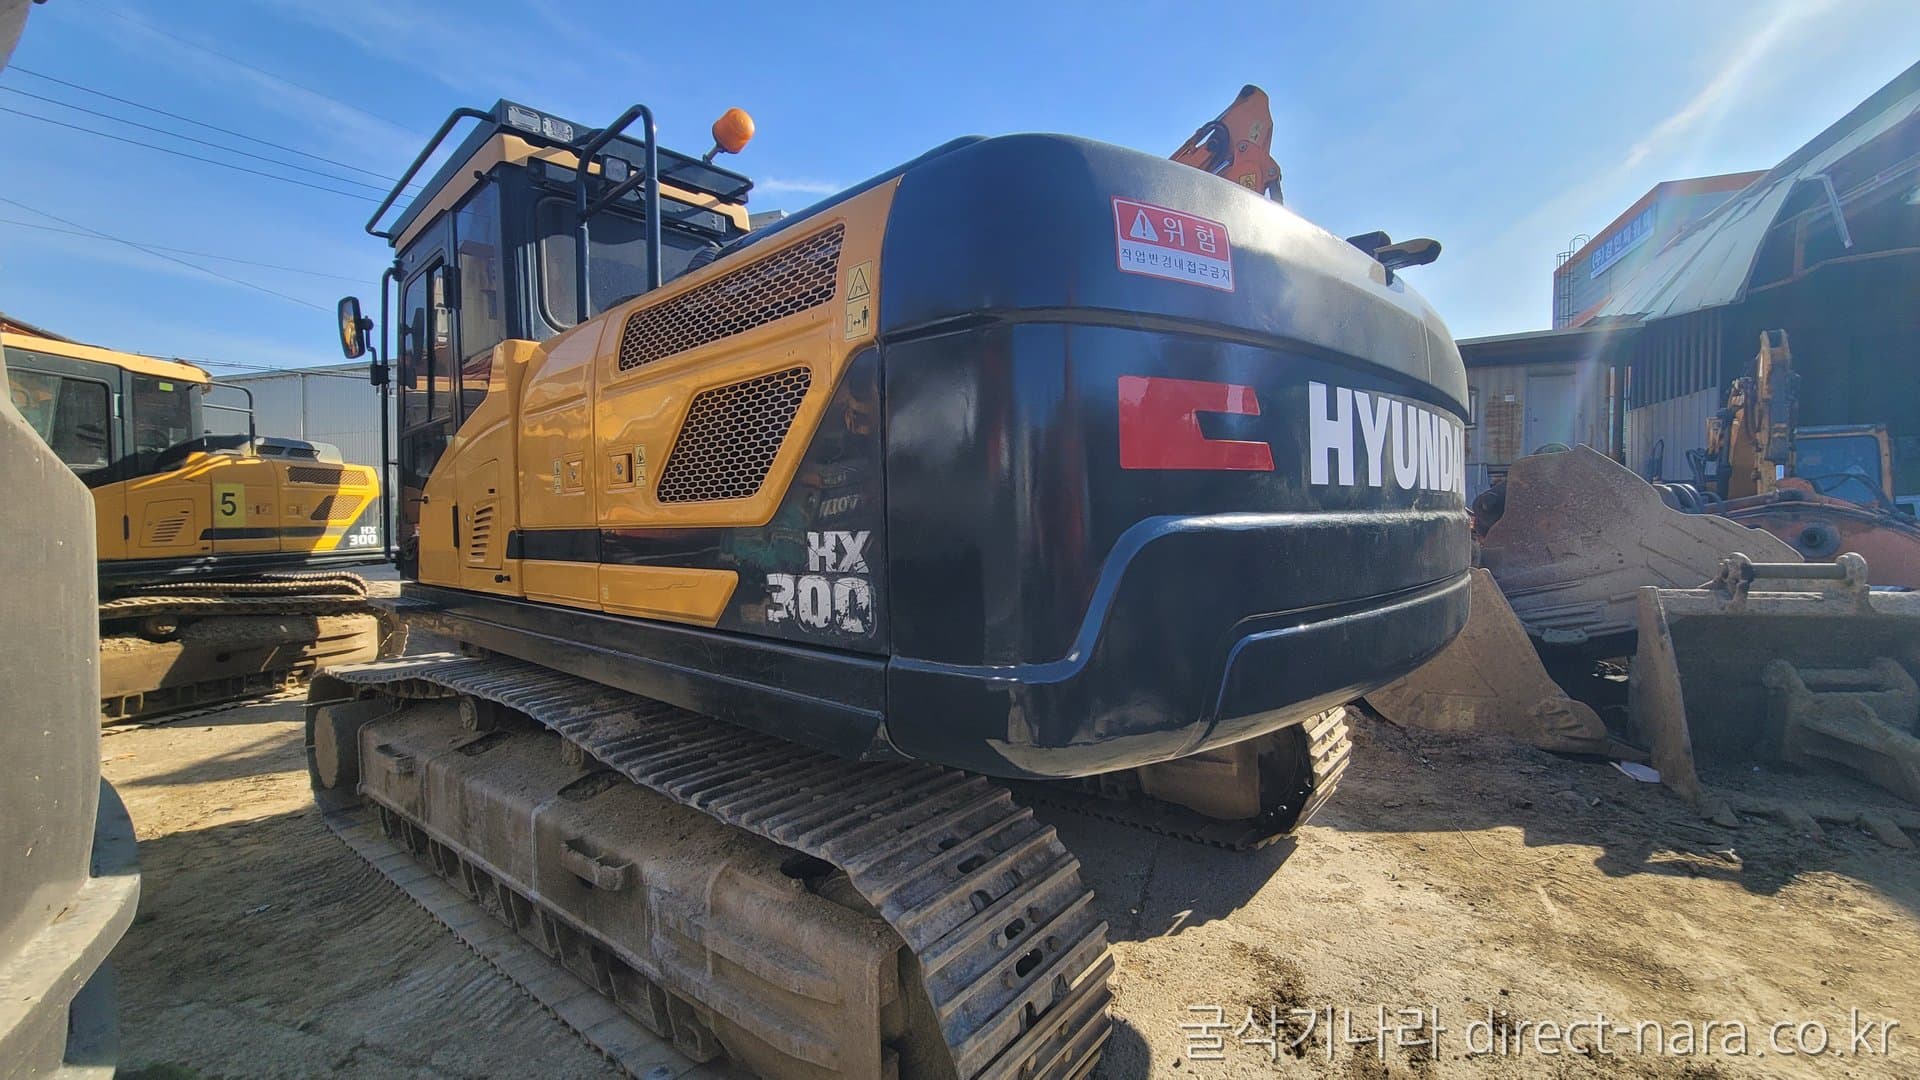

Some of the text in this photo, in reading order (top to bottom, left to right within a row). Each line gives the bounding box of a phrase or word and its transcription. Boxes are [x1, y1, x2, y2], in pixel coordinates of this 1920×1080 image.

[221, 492, 236, 516] 5
[349, 534, 377, 545] 300
[360, 526, 377, 535] HX
[807, 531, 871, 574] HX
[766, 573, 874, 633] 300
